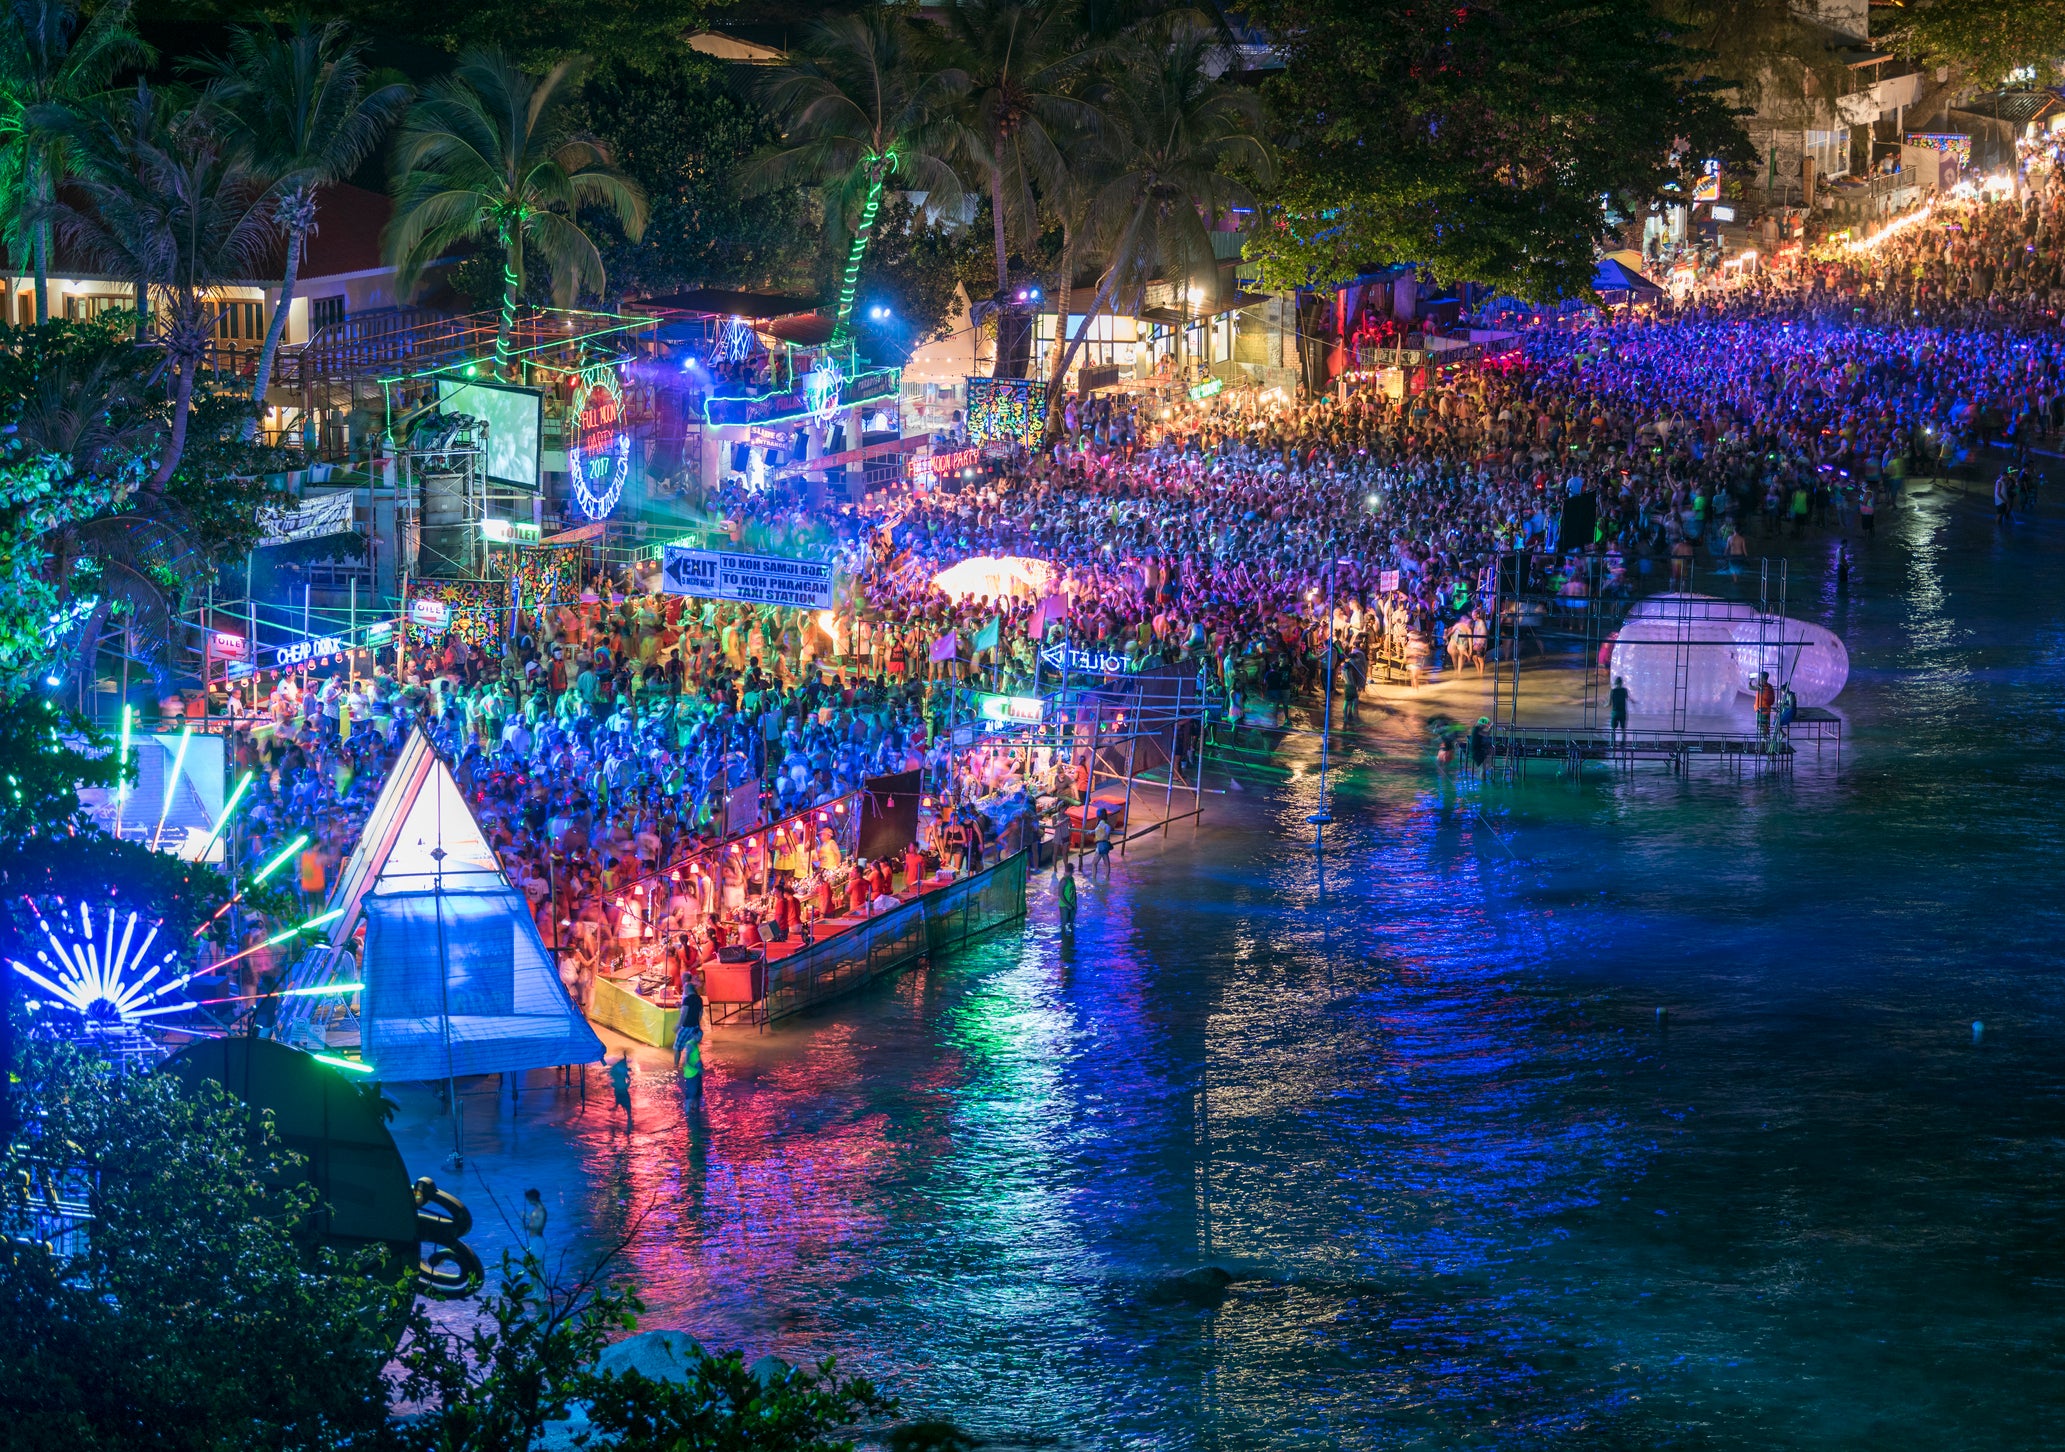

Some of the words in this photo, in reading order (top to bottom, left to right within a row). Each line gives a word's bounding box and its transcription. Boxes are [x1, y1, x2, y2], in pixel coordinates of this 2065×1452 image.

[582, 408, 599, 430] FULL
[600, 403, 617, 425] MOON
[587, 429, 614, 457] PARTY
[750, 426, 776, 439] SLIDE
[589, 457, 610, 479] 2017
[931, 454, 951, 472] MOON
[953, 448, 980, 469] PARTY
[682, 558, 717, 578] EXIT
[722, 557, 736, 568] TO
[738, 559, 760, 571] KOH
[801, 565, 829, 578] BOAT
[722, 573, 739, 585] TO
[741, 575, 767, 588] KOH
[769, 577, 828, 594] PHANGAN
[737, 586, 763, 599] TAXI
[766, 589, 816, 605] STATION
[213, 635, 247, 649] TOILET
[276, 644, 312, 664] CHEAP
[313, 636, 343, 657] DRINK
